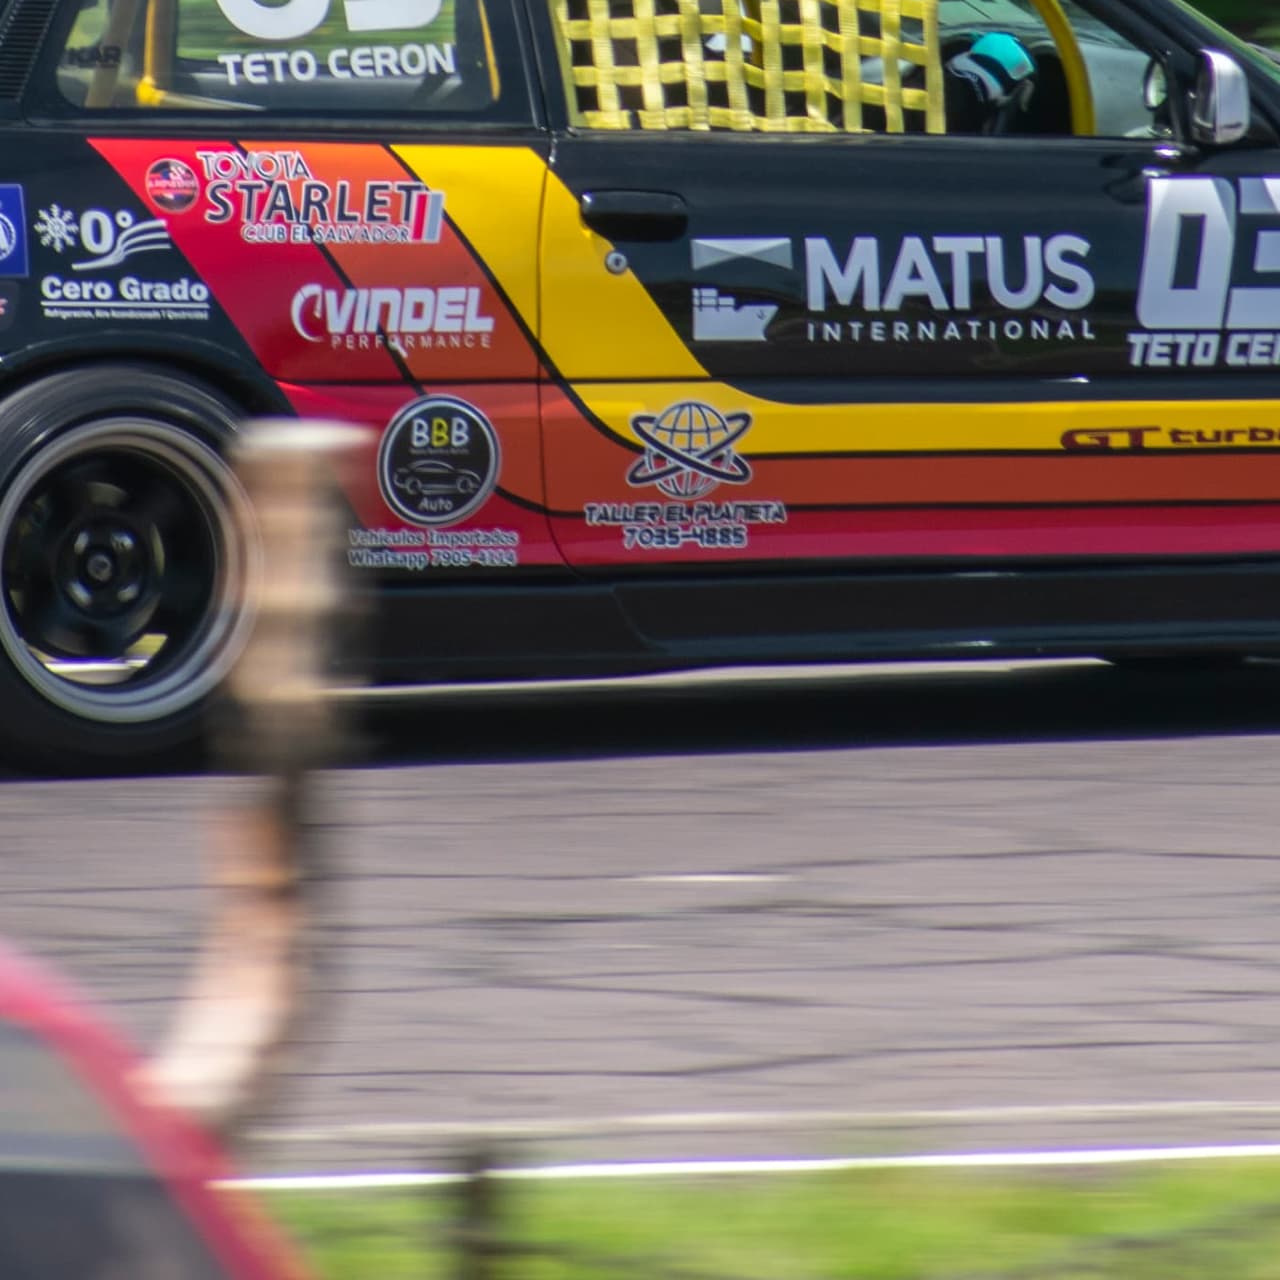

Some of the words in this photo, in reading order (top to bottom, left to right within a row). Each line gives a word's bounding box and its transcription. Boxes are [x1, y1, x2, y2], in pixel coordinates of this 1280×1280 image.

[217, 50, 318, 85] TETO
[327, 41, 456, 80] CERON
[196, 150, 313, 181] TOYOTA
[203, 180, 426, 224] STARLET
[240, 223, 287, 243] CLUB
[290, 223, 312, 243] EL
[312, 224, 411, 244] SALVADOR
[805, 235, 1095, 312] MATUS
[41, 276, 114, 301] Cero
[119, 276, 209, 303] Grado
[331, 333, 492, 350] PERFORMANCE
[807, 319, 1096, 343] INTERNATIONAL
[1127, 332, 1216, 367] TETO
[410, 417, 470, 448] BBB
[1060, 426, 1161, 450] GT
[418, 497, 454, 512] Auto
[584, 503, 660, 525] TALLER
[664, 504, 691, 523] EL
[693, 501, 787, 523] PLANETA
[426, 529, 519, 549] Importados
[624, 524, 747, 549] 7035-4885
[348, 549, 429, 569] Whatsapp
